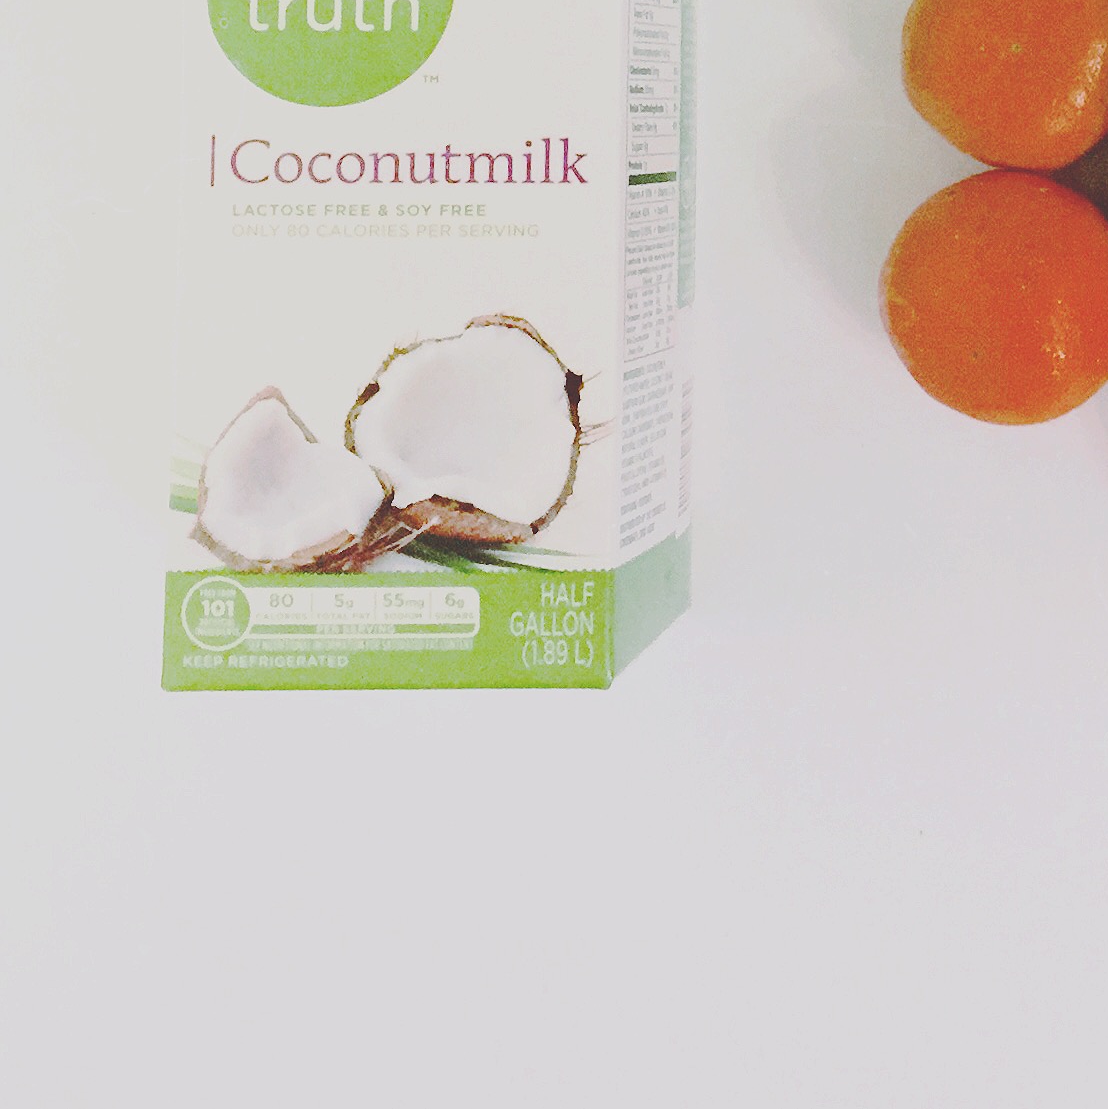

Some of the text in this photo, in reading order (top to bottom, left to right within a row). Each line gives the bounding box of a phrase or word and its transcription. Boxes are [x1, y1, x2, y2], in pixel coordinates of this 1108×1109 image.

[230, 137, 590, 184] Coconutmilk
[232, 203, 487, 217] LACTOSE FREE & SOY FREE
[231, 223, 540, 238] ONLY 80 CALORIES PER SERVING
[269, 593, 294, 609] 80
[444, 592, 466, 609] 6g
[540, 581, 595, 608] HALF
[201, 599, 235, 618] 101
[509, 610, 595, 637] GALLON
[182, 654, 350, 670] KEEP REFRIGERATED
[573, 638, 595, 668] L)
